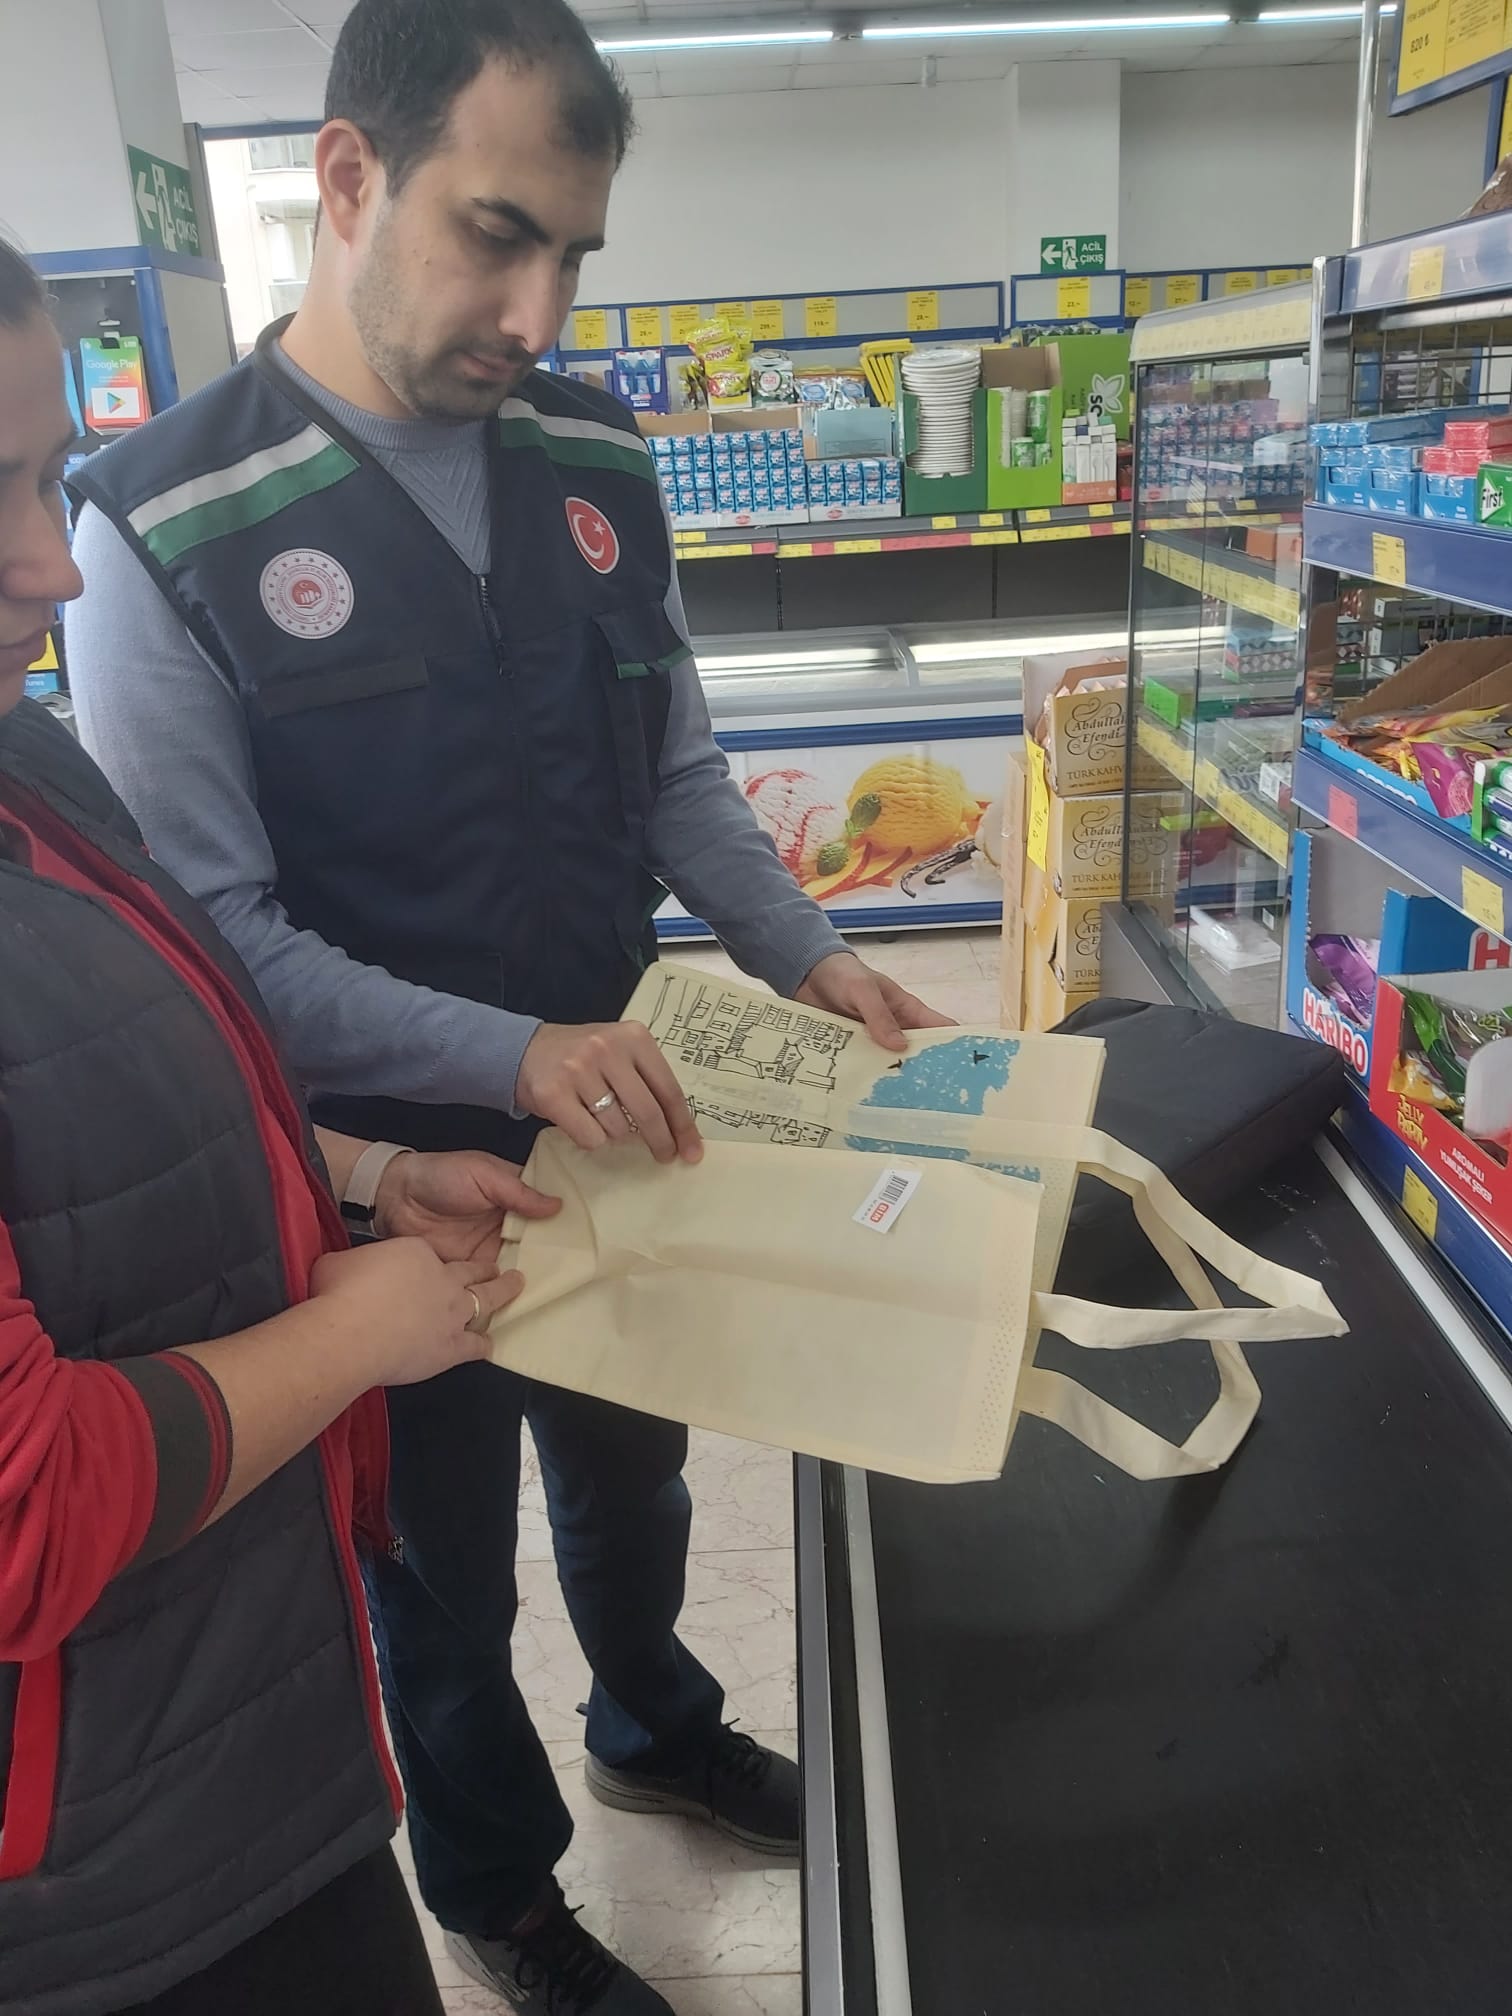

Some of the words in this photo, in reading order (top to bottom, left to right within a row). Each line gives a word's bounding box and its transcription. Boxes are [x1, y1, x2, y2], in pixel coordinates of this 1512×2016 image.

[1081, 240, 1103, 252] ACİL
[1080, 253, 1104, 265] ÇIKIŞ
[86, 358, 119, 370] Google
[119, 358, 138, 369] Play
[1482, 486, 1502, 509] First
[1082, 726, 1121, 744] Efendi
[1066, 768, 1096, 780] TÜRK
[1096, 765, 1122, 776] KAHV
[1089, 837, 1121, 850] Efend
[1072, 873, 1100, 884] TÜRK
[1303, 988, 1368, 1077] HARIBO
[1397, 1094, 1425, 1126] JELLY
